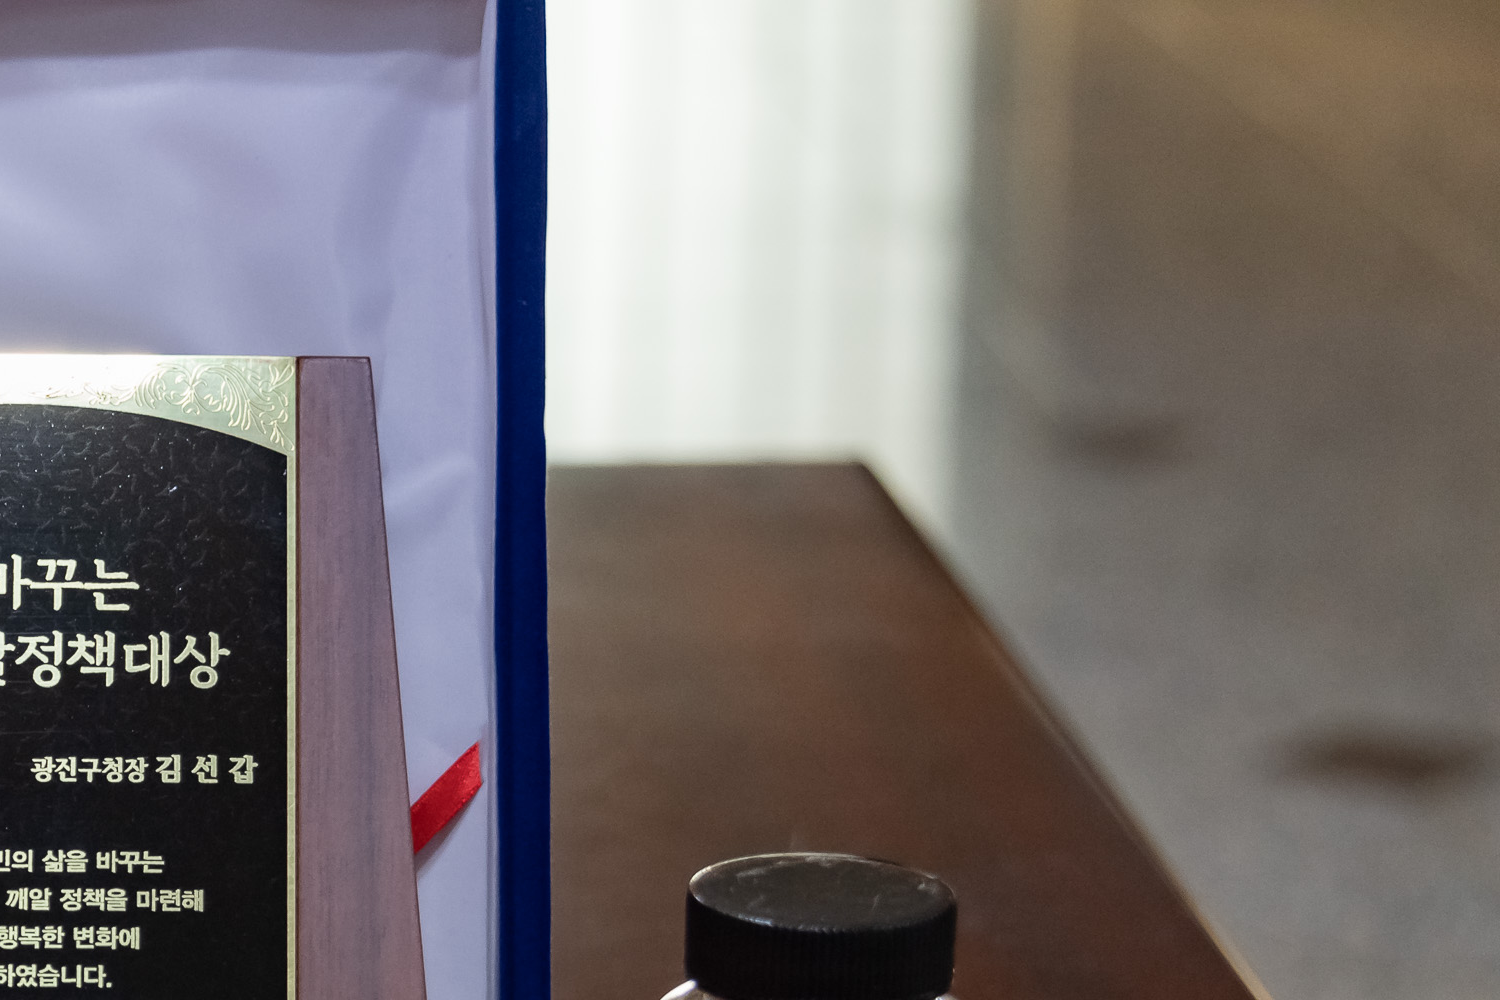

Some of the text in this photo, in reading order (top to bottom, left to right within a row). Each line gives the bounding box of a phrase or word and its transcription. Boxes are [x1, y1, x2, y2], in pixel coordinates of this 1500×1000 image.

[29, 755, 150, 784] 광진구청장
[42, 850, 88, 873] 삶을
[96, 850, 165, 873] 바꾸는
[5, 888, 52, 911] 깨알
[59, 888, 128, 912] 정책을
[136, 889, 204, 912] 마련해
[73, 926, 141, 950] 변화에
